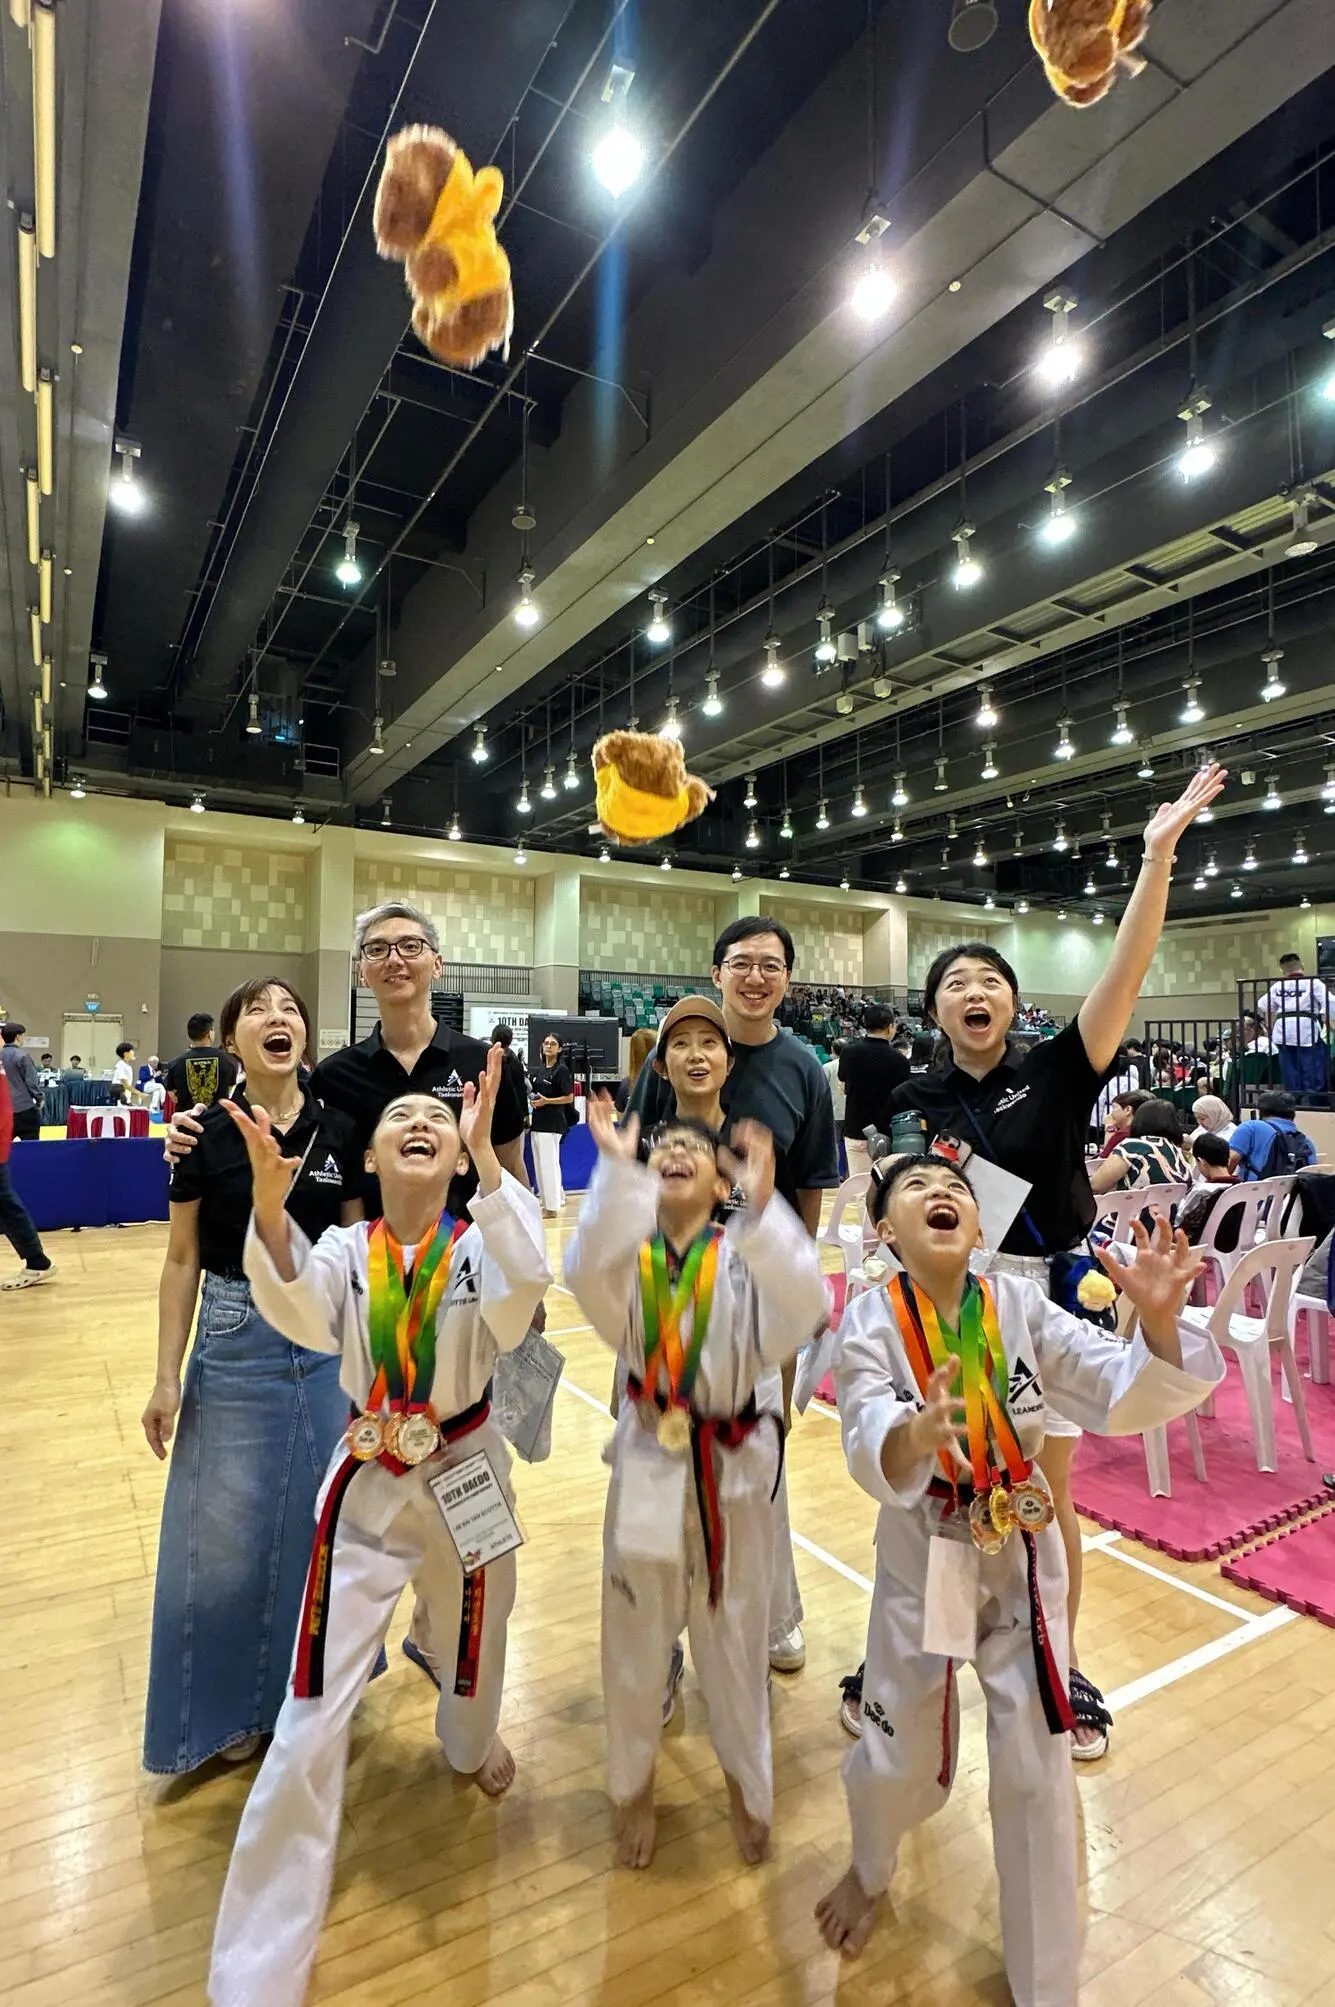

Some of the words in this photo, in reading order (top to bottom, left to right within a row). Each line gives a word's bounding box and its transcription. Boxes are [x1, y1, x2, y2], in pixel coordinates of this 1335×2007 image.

[994, 1093, 1027, 1114] aekwondo
[441, 1489, 463, 1505] 10TH
[462, 1470, 491, 1494] DAEDO
